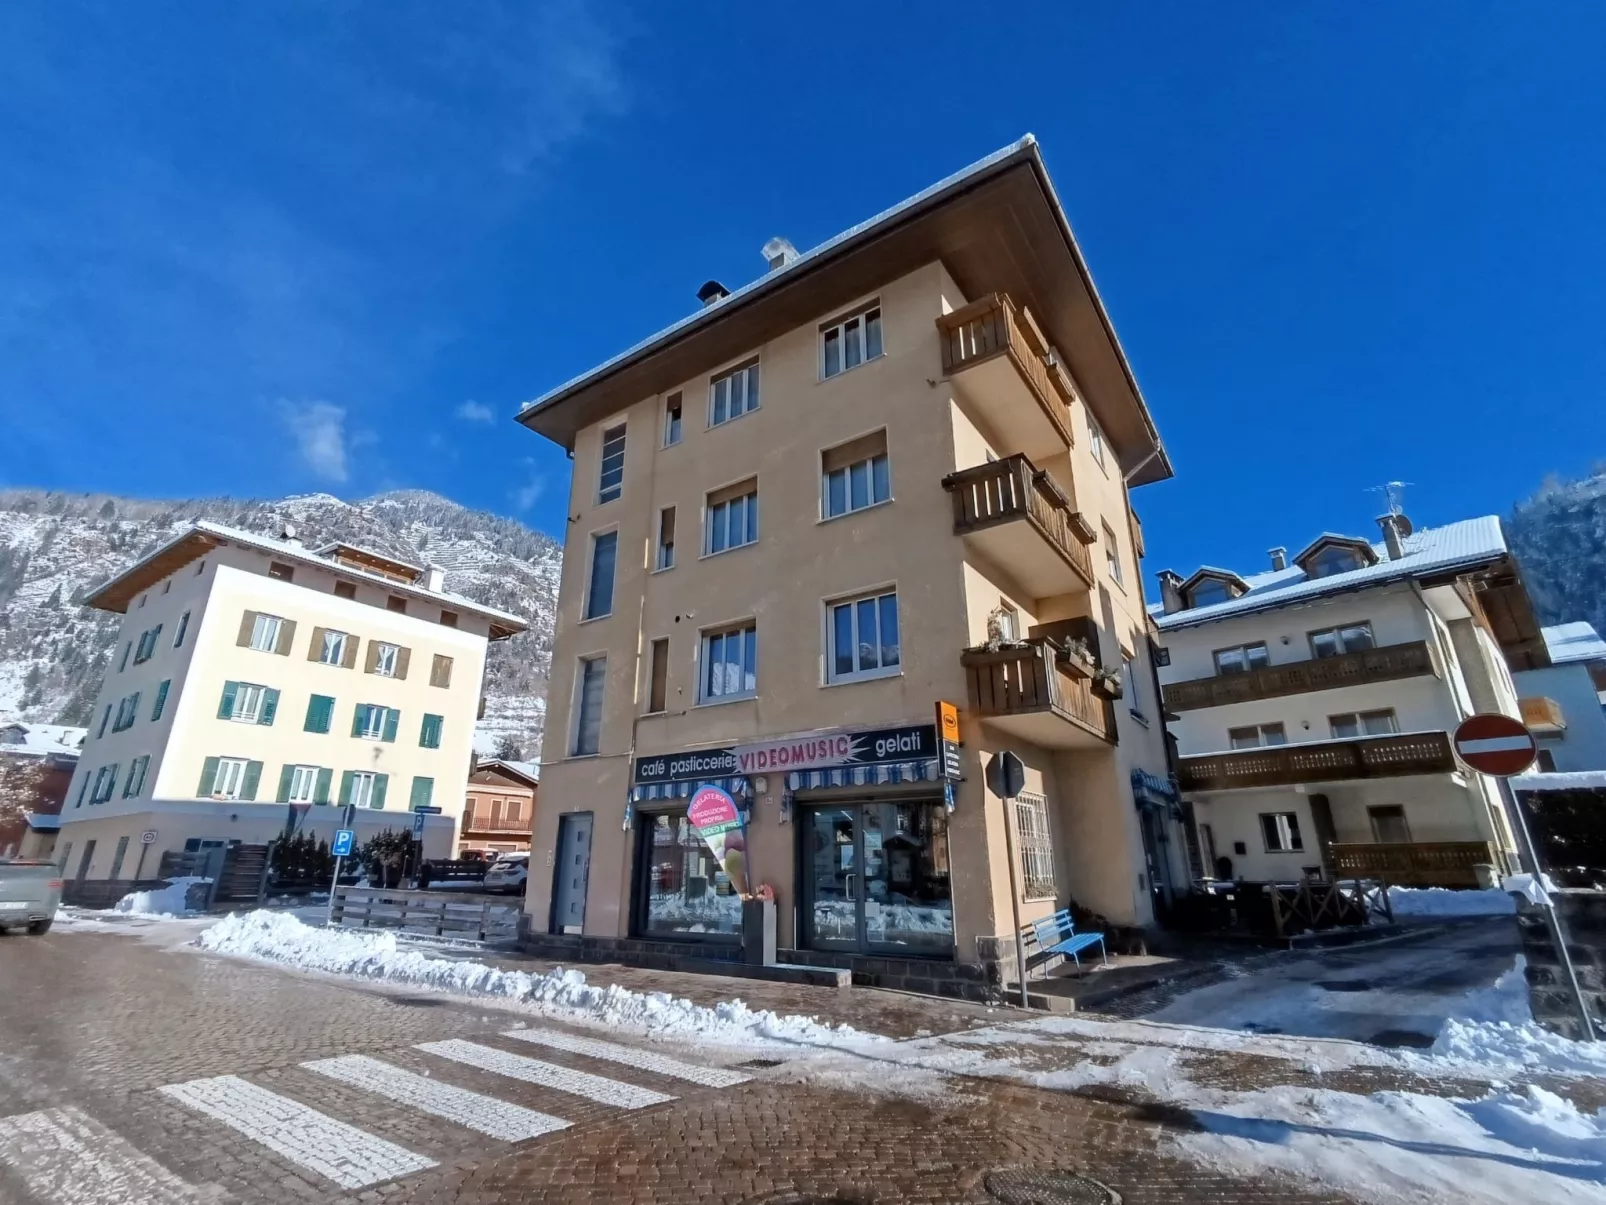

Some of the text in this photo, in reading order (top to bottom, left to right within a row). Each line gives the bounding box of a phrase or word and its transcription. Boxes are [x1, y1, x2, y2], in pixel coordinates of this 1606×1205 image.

[641, 732, 921, 777] café pasticceria VIDEOMUSIC gelati
[692, 793, 726, 809] GELATERIA
[701, 825, 720, 836] VIDEO
[339, 832, 350, 846] P
